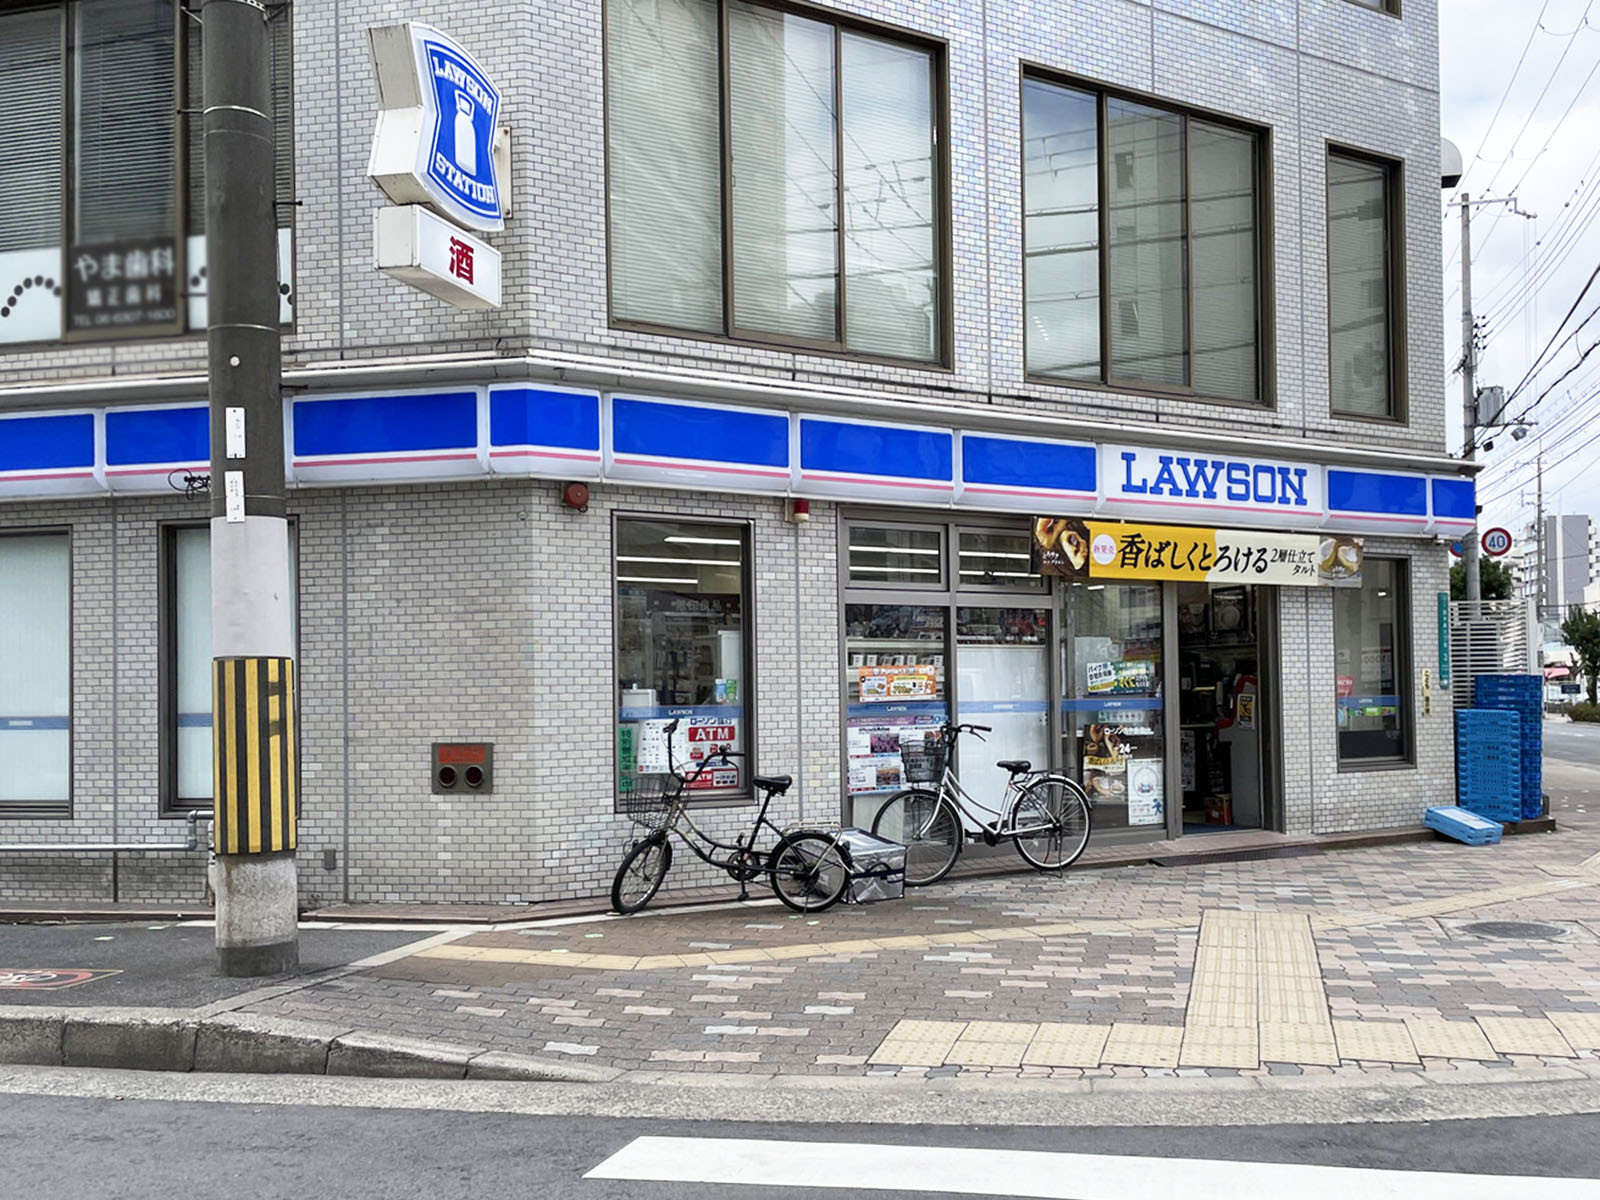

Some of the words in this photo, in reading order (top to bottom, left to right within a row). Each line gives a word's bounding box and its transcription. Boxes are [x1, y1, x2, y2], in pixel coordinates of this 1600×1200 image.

[432, 55, 494, 116] LAWSON
[435, 151, 497, 204] STATION
[74, 247, 175, 282] やま歯科
[449, 235, 475, 285] 酒
[1121, 452, 1307, 506] LAWSON
[1117, 532, 1269, 573] 香ばしくとろける
[1270, 548, 1315, 564] 2層仕立て
[1488, 535, 1505, 548] 40
[1292, 564, 1316, 576] タルト
[695, 728, 729, 740] ATM
[1119, 743, 1131, 754] 24
